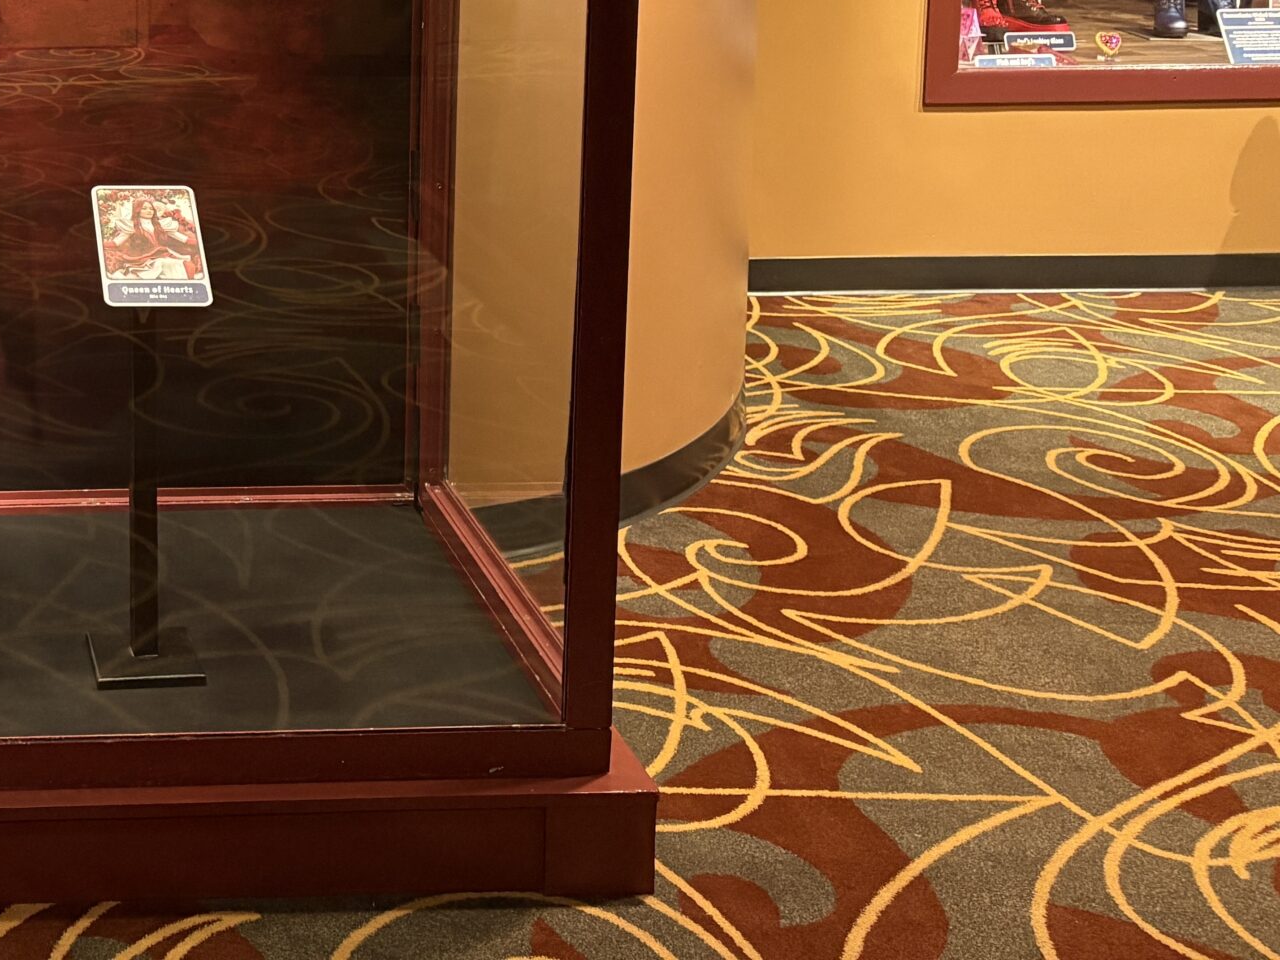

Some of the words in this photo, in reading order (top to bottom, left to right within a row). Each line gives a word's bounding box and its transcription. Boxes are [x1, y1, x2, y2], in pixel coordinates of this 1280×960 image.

[121, 286, 150, 295] Queen
[152, 285, 162, 294] of
[163, 286, 194, 294] Hearts
